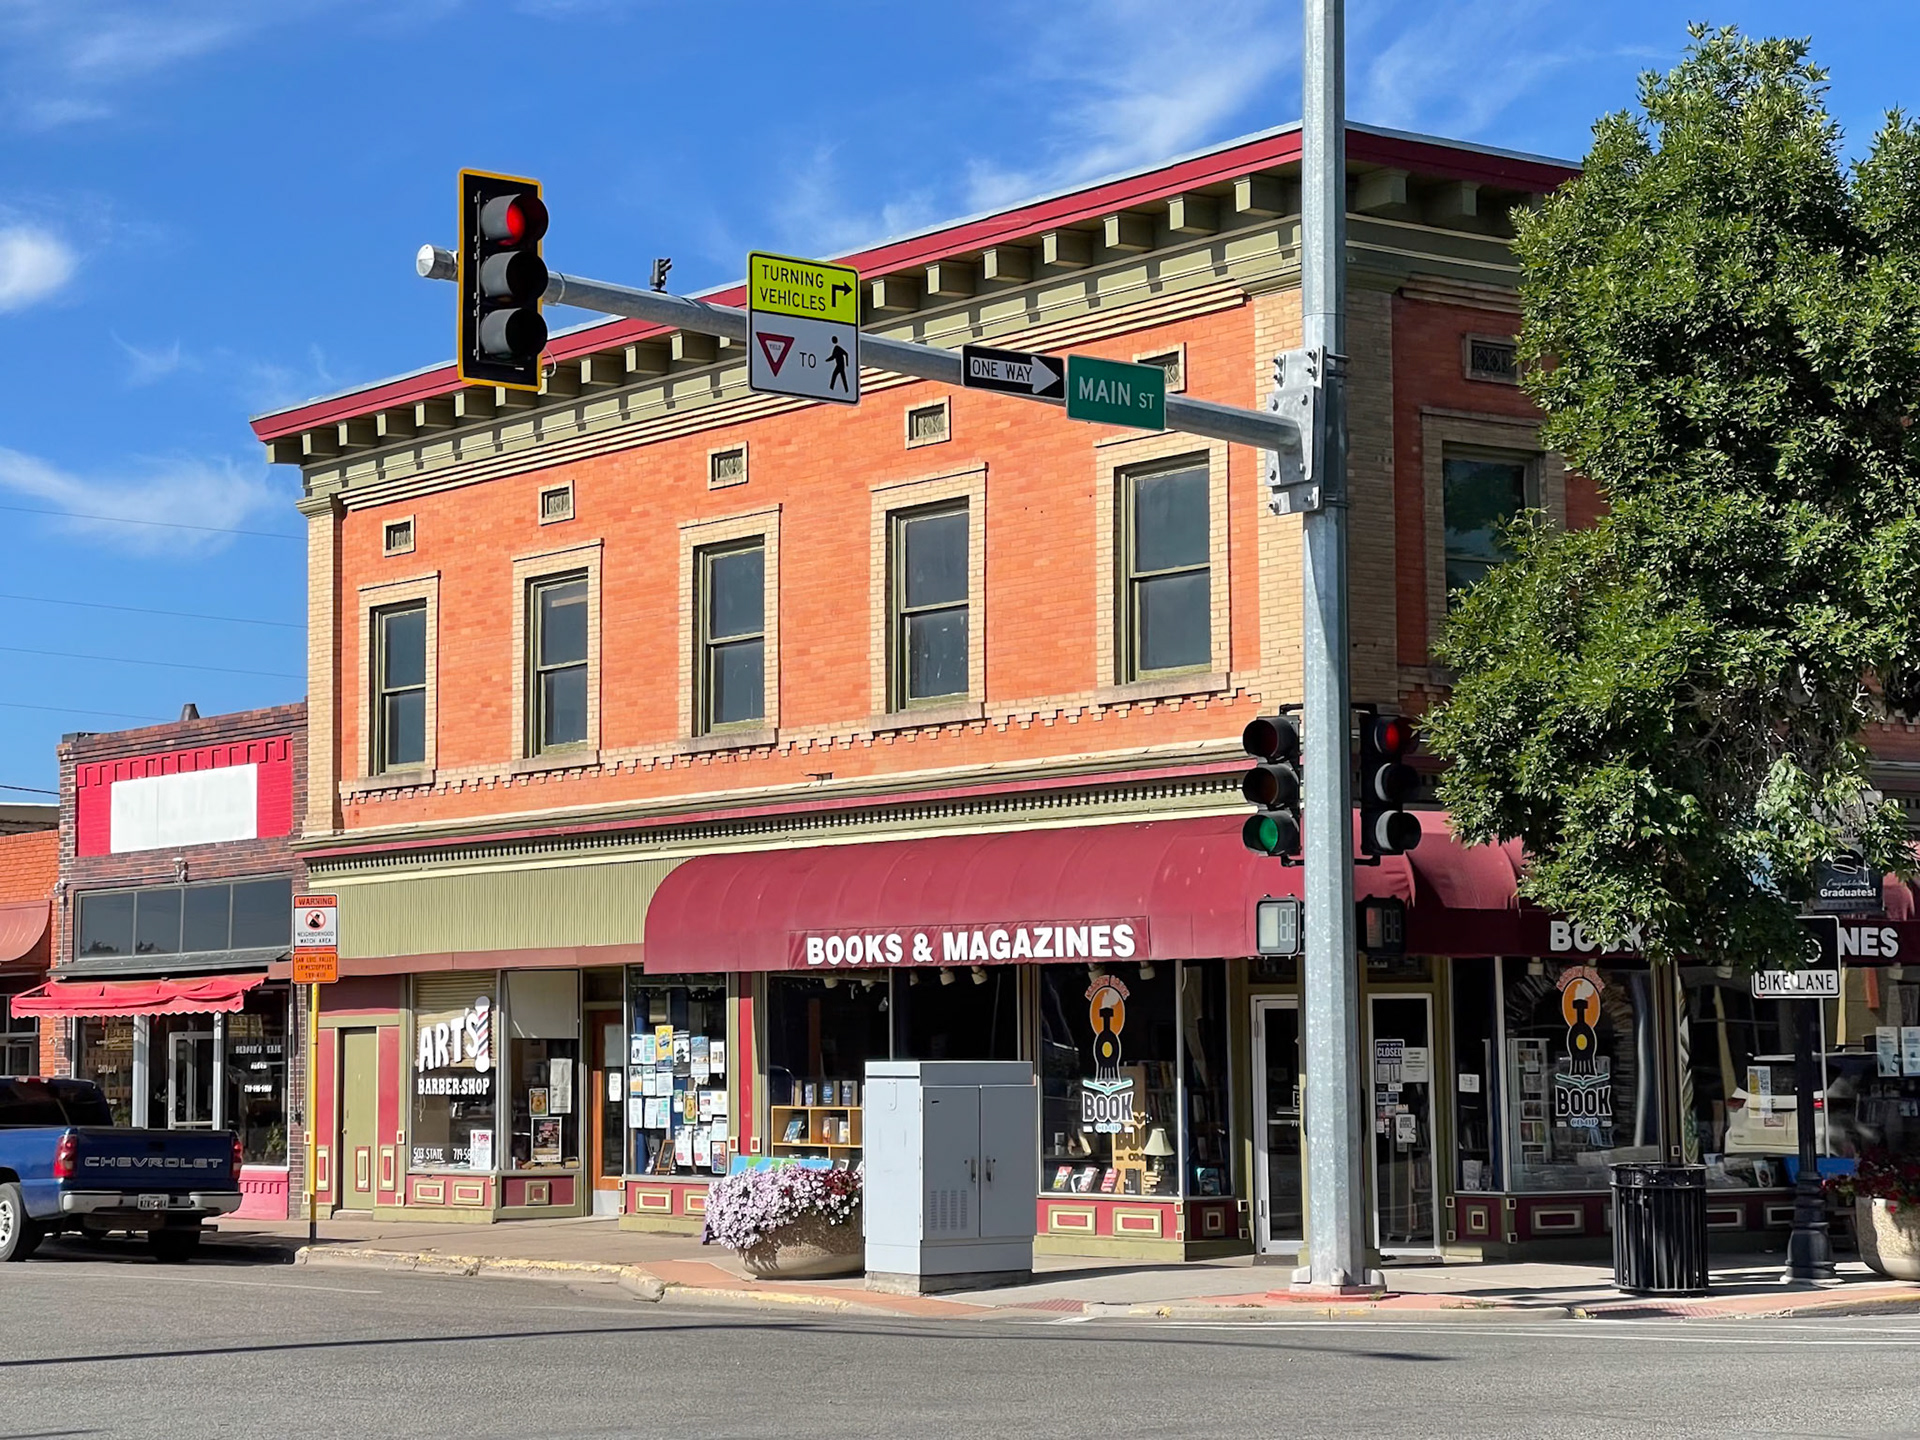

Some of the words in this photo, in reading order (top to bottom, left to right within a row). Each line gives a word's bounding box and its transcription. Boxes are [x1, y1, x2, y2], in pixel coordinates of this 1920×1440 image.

[761, 264, 824, 289] TURNING
[759, 287, 826, 312] VEHICLES
[799, 352, 817, 369] TO
[972, 359, 998, 378] ONE
[1005, 363, 1033, 382] WAY
[1079, 376, 1131, 407] MAIN
[1138, 392, 1155, 410] ST
[298, 897, 333, 906] WARNING
[1819, 887, 1877, 898] Graduates!
[806, 933, 904, 966] BOOKS
[911, 932, 934, 963] &
[941, 923, 1136, 962] MAGAZINES
[1758, 974, 1791, 991] BIKE
[1797, 974, 1834, 991] LANE
[418, 1007, 479, 1074] ART'S
[1081, 1090, 1135, 1123] BOOK
[1554, 1084, 1613, 1117] BOOK
[84, 1156, 224, 1169] CHEVROLET
[413, 1147, 424, 1160] 503
[425, 1147, 444, 1160] STATE
